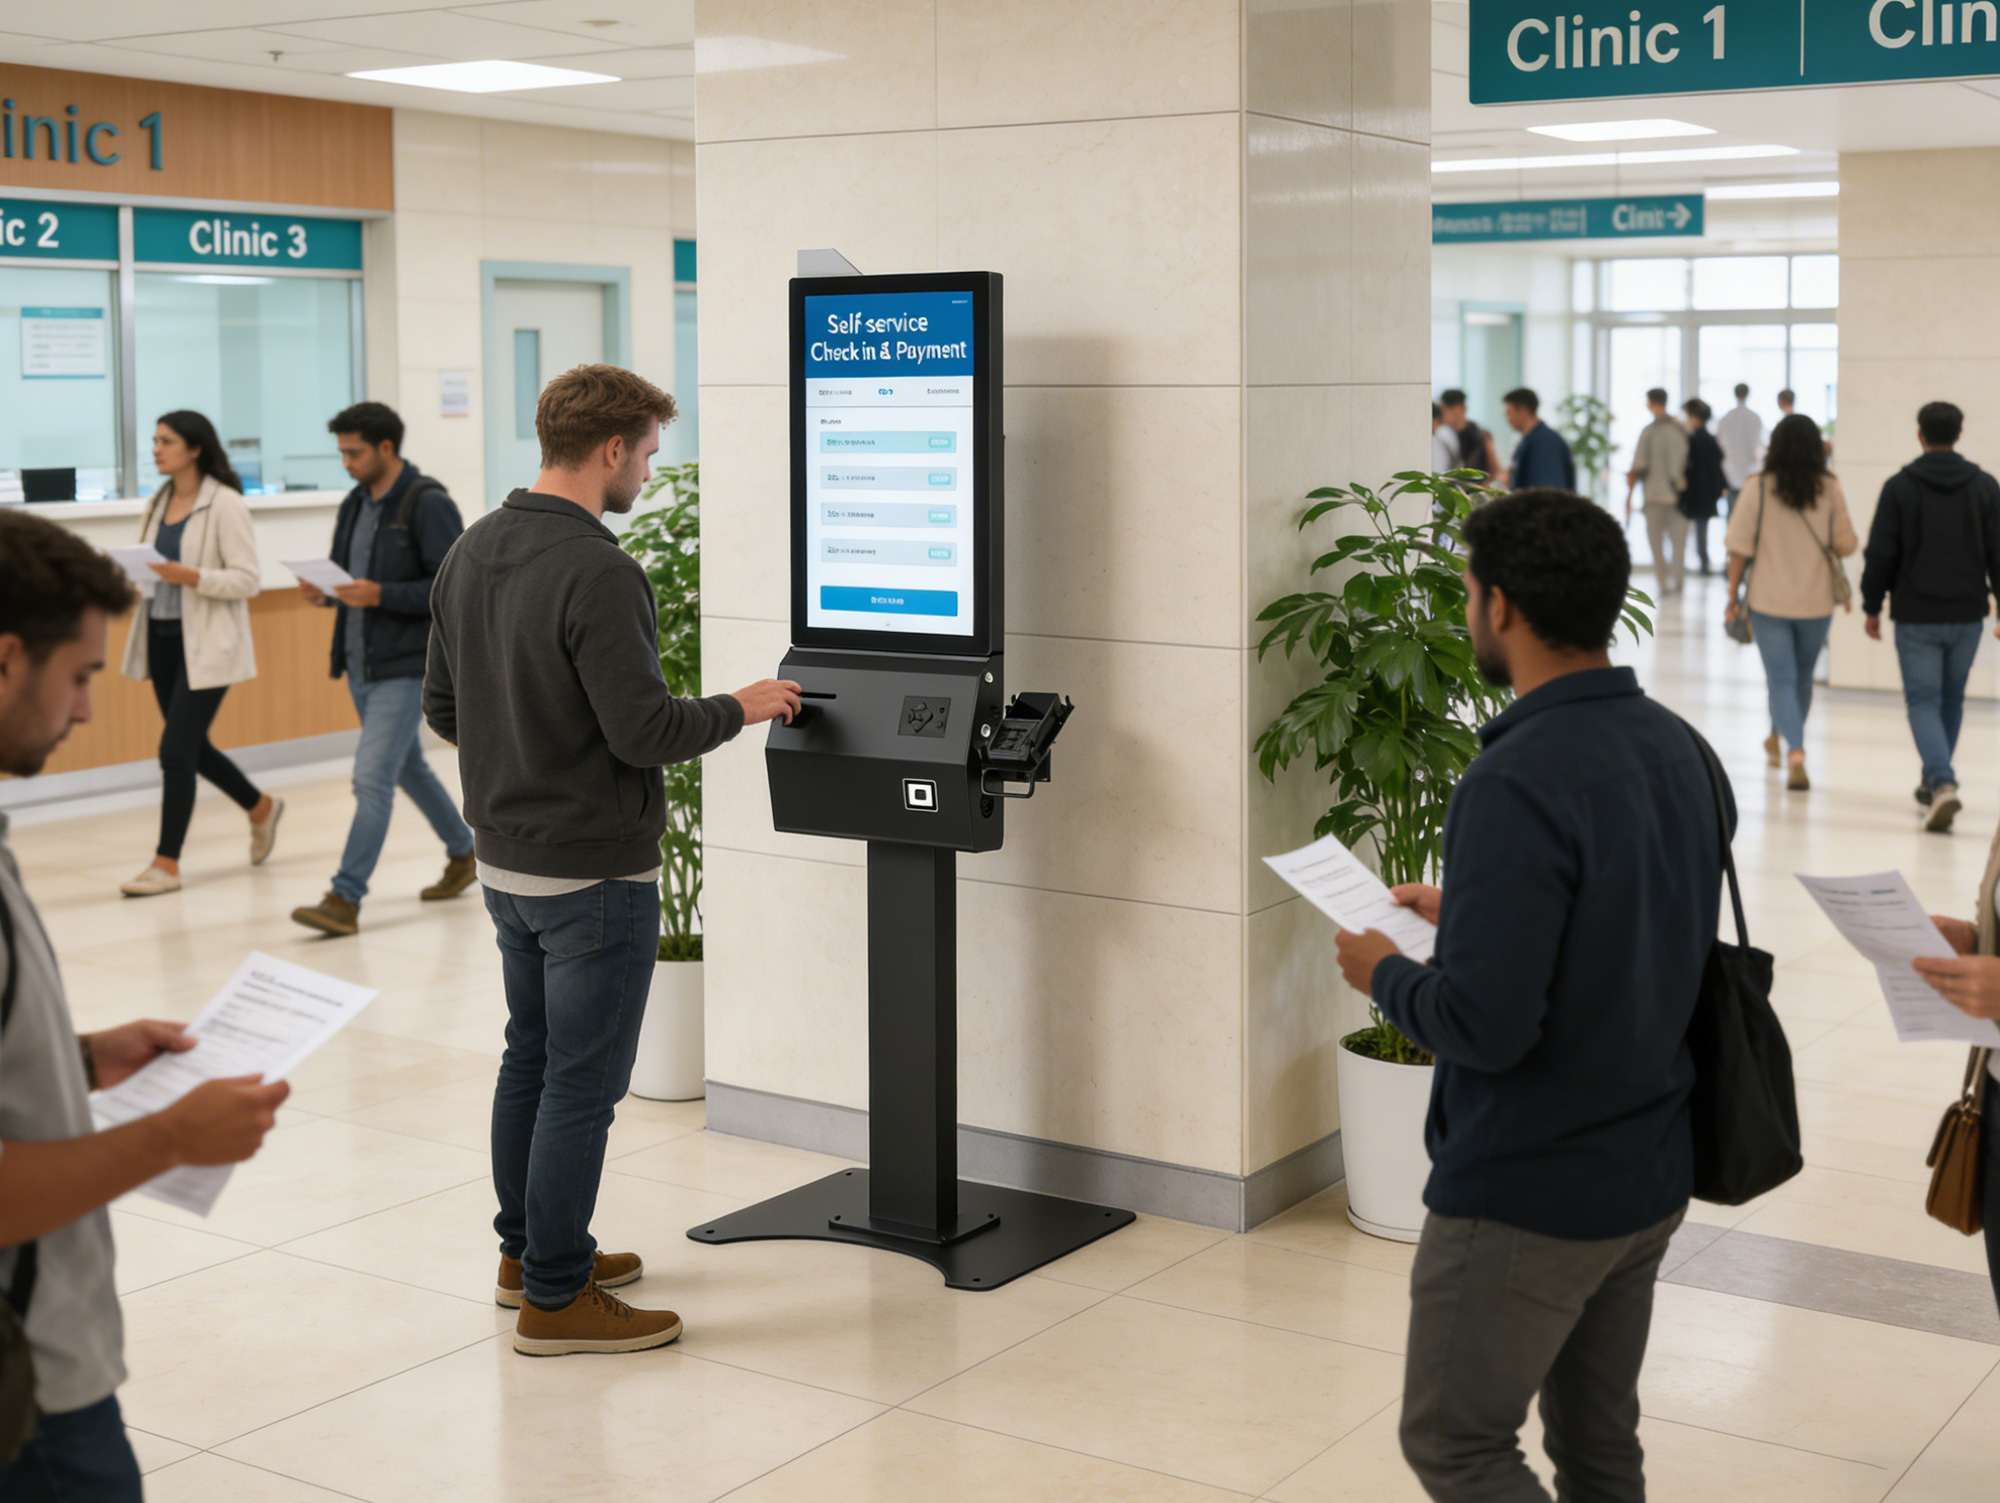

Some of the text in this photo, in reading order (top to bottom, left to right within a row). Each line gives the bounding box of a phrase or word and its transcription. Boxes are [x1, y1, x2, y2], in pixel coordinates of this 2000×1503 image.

[1507, 5, 1725, 72] Clinic 1
[139, 112, 163, 170] 1
[37, 211, 60, 249] 2
[189, 219, 308, 259] Clinic 3
[827, 311, 929, 335] Self service
[810, 340, 860, 362] Check
[862, 340, 877, 361] in
[896, 340, 968, 366] Payment
